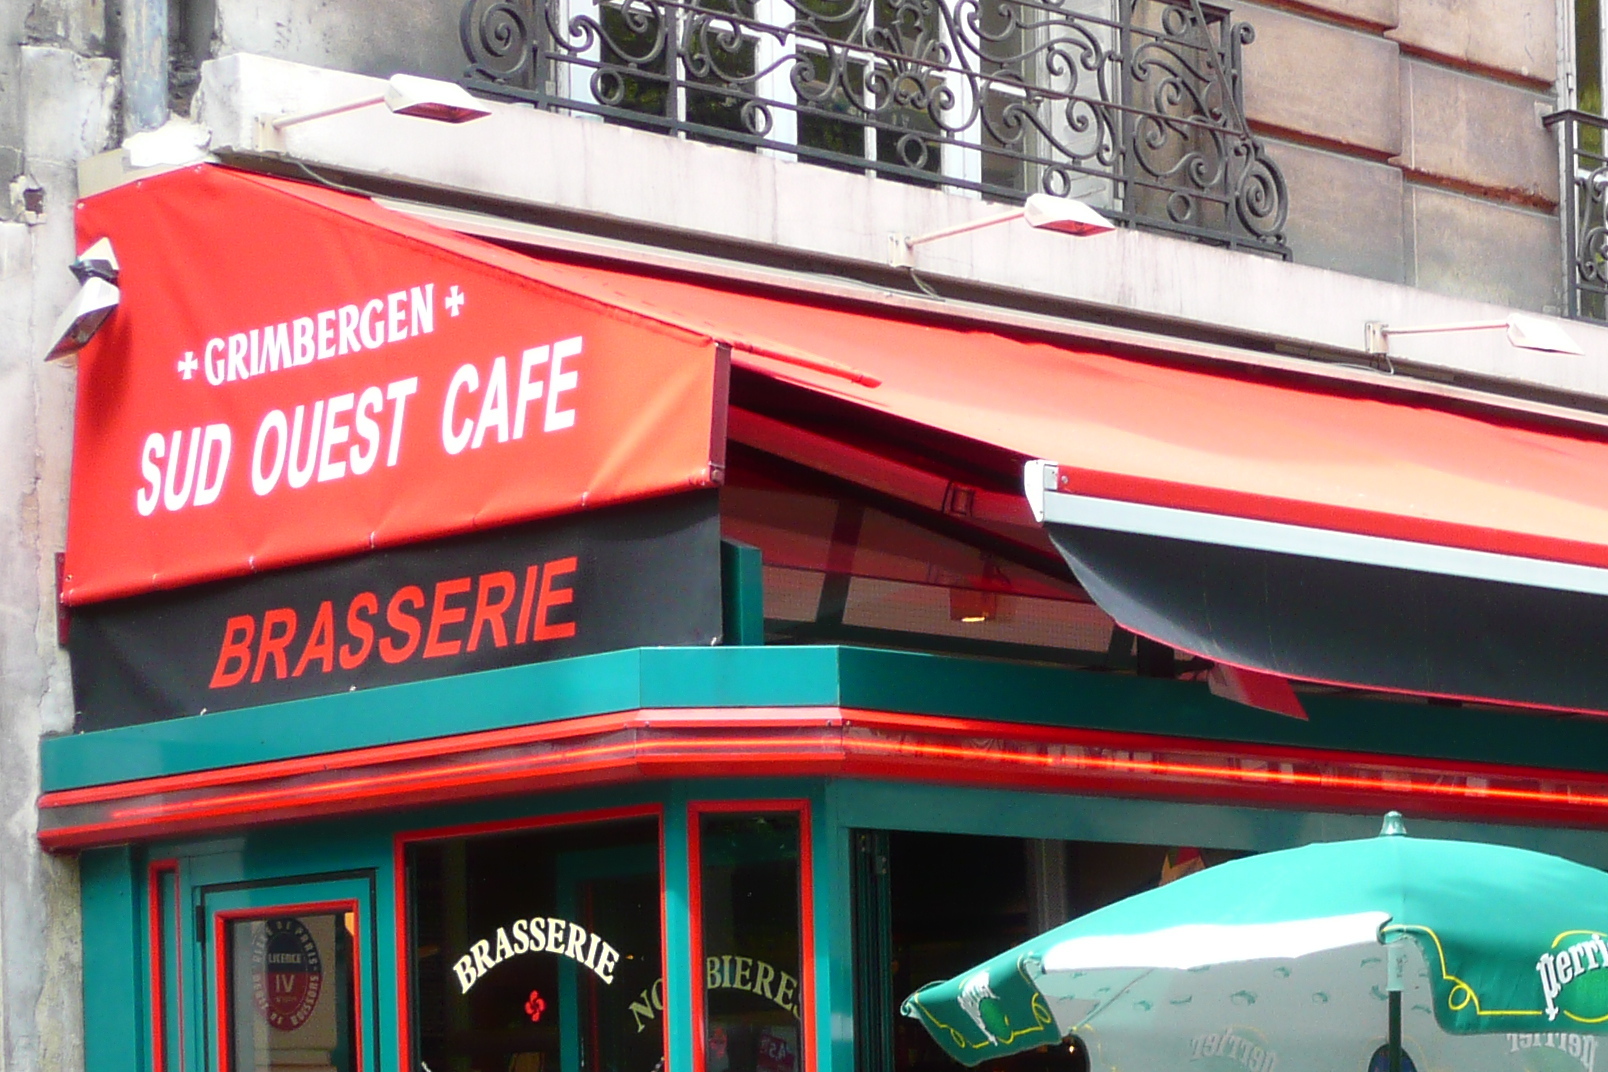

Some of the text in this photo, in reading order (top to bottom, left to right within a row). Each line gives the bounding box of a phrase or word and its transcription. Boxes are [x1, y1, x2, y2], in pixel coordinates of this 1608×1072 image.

[203, 283, 435, 386] GRIMBERGEN
[136, 335, 583, 517] SUD OUEST CAFE
[208, 556, 578, 689] BRASSERIE
[268, 953, 302, 964] LICENCE
[275, 974, 295, 993] IV
[453, 916, 620, 995] BRASSERIE
[628, 955, 800, 1033] NO BIERE
